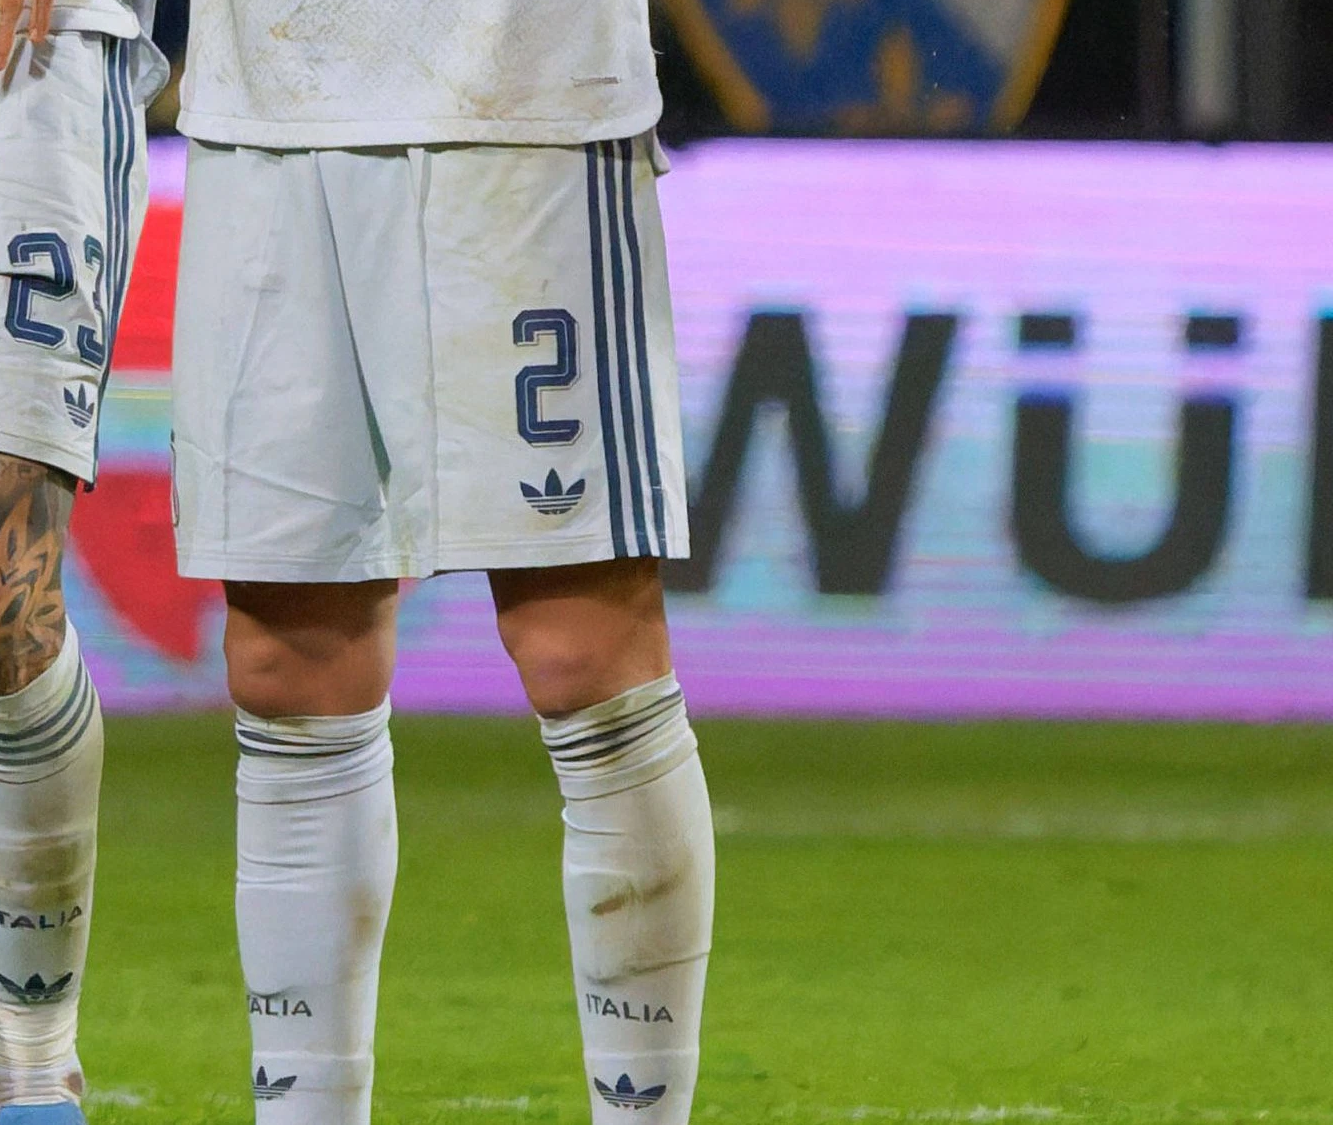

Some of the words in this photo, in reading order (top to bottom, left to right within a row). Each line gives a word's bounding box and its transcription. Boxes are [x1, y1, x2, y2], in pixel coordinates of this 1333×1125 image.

[513, 309, 583, 447] 2
[658, 312, 1333, 602] WÜ
[247, 995, 312, 1017] ALIA
[586, 993, 673, 1023] ITALIA
